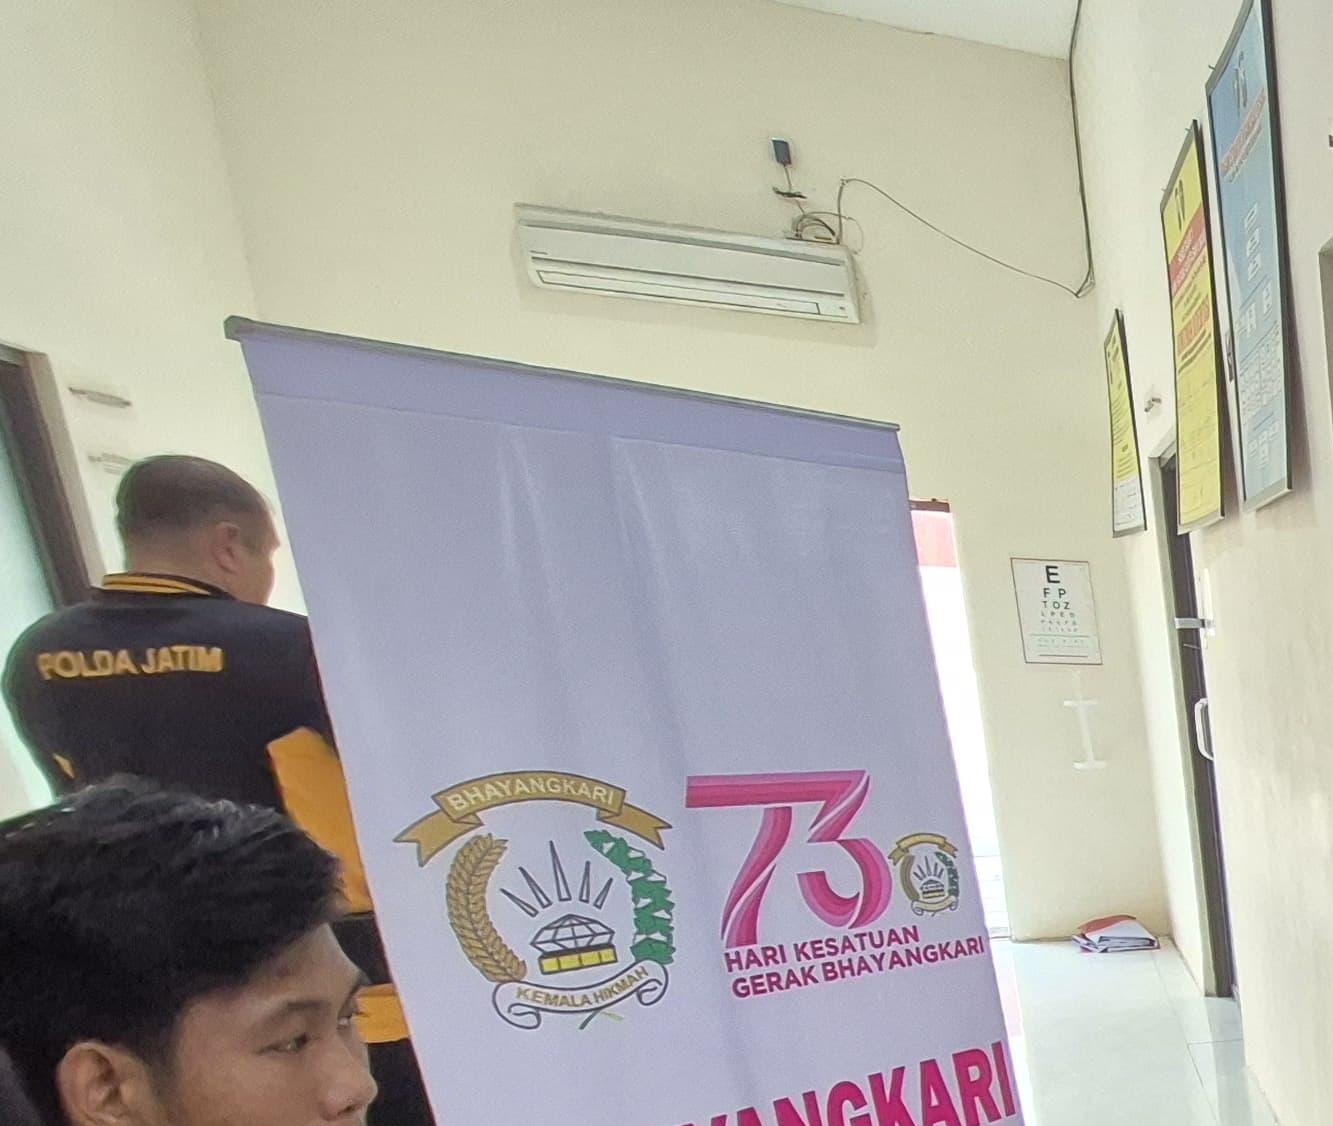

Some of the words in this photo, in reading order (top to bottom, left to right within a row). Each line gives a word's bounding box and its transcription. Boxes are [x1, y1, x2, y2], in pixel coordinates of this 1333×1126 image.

[1045, 565, 1060, 583] E
[38, 649, 139, 680] POLDA
[141, 644, 224, 674] JATIM
[449, 778, 616, 811] BHAYANGKARI
[685, 769, 893, 949] 73
[724, 944, 787, 972] HARI
[793, 925, 920, 963] KESATUAN
[731, 965, 819, 998] GERAK
[822, 936, 985, 982] BHAYANGKARI
[517, 986, 592, 1008] KEMALA
[594, 966, 650, 1003] HIKMAH
